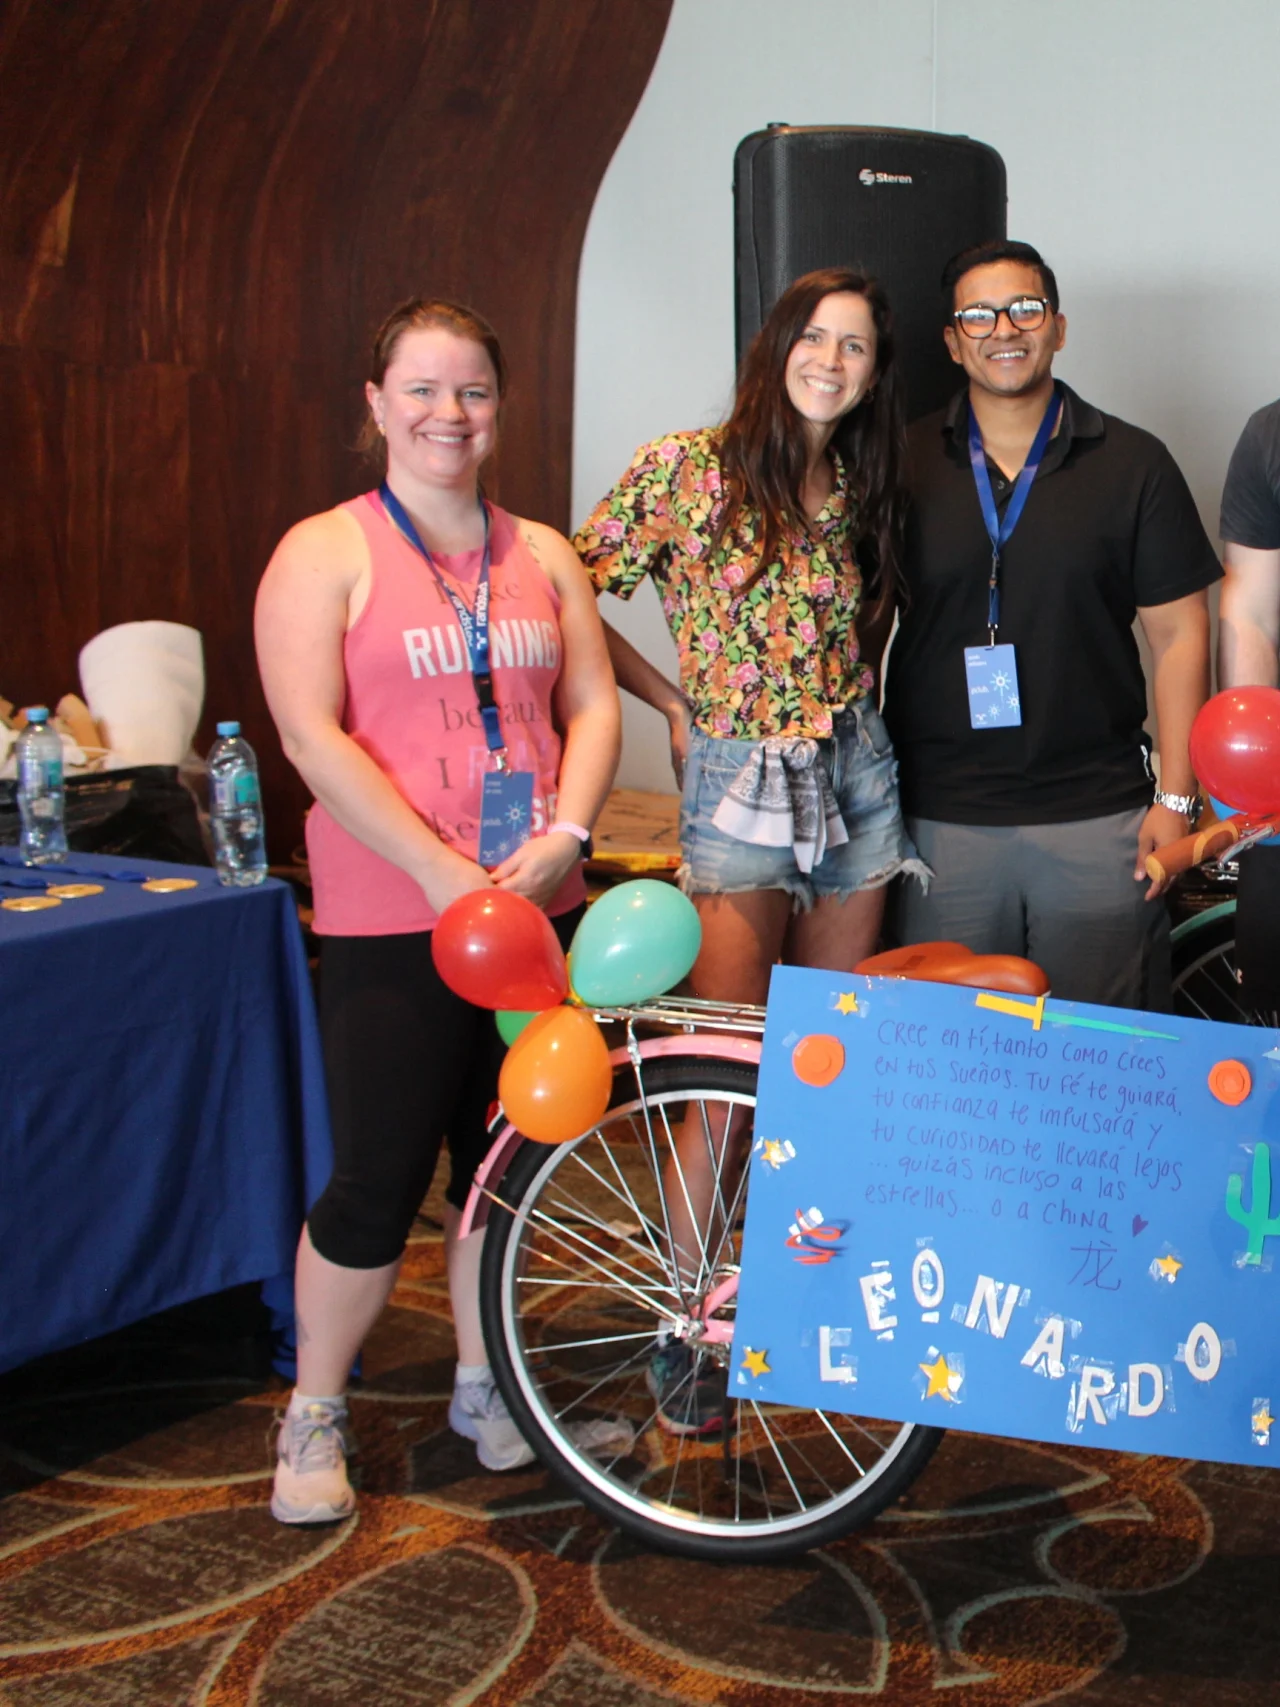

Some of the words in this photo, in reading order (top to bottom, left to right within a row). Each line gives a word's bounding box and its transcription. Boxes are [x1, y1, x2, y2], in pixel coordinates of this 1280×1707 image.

[876, 172, 913, 184] Steren
[942, 1028, 960, 1049] en
[992, 1032, 1048, 1060] tanto
[1087, 1080, 1108, 1101] te
[1008, 1099, 1030, 1126] te
[1148, 1122, 1164, 1152] y
[898, 1153, 974, 1181] quizás
[984, 1162, 1060, 1193] incluso
[1071, 1176, 1084, 1193] a
[1098, 1176, 1127, 1201] las
[1022, 1137, 1042, 1163] te
[1133, 1151, 1183, 1193] lejos
[1017, 1201, 1030, 1220] a
[1068, 1239, 1122, 1292] 龙
[819, 1248, 1222, 1425] LEONARDO
